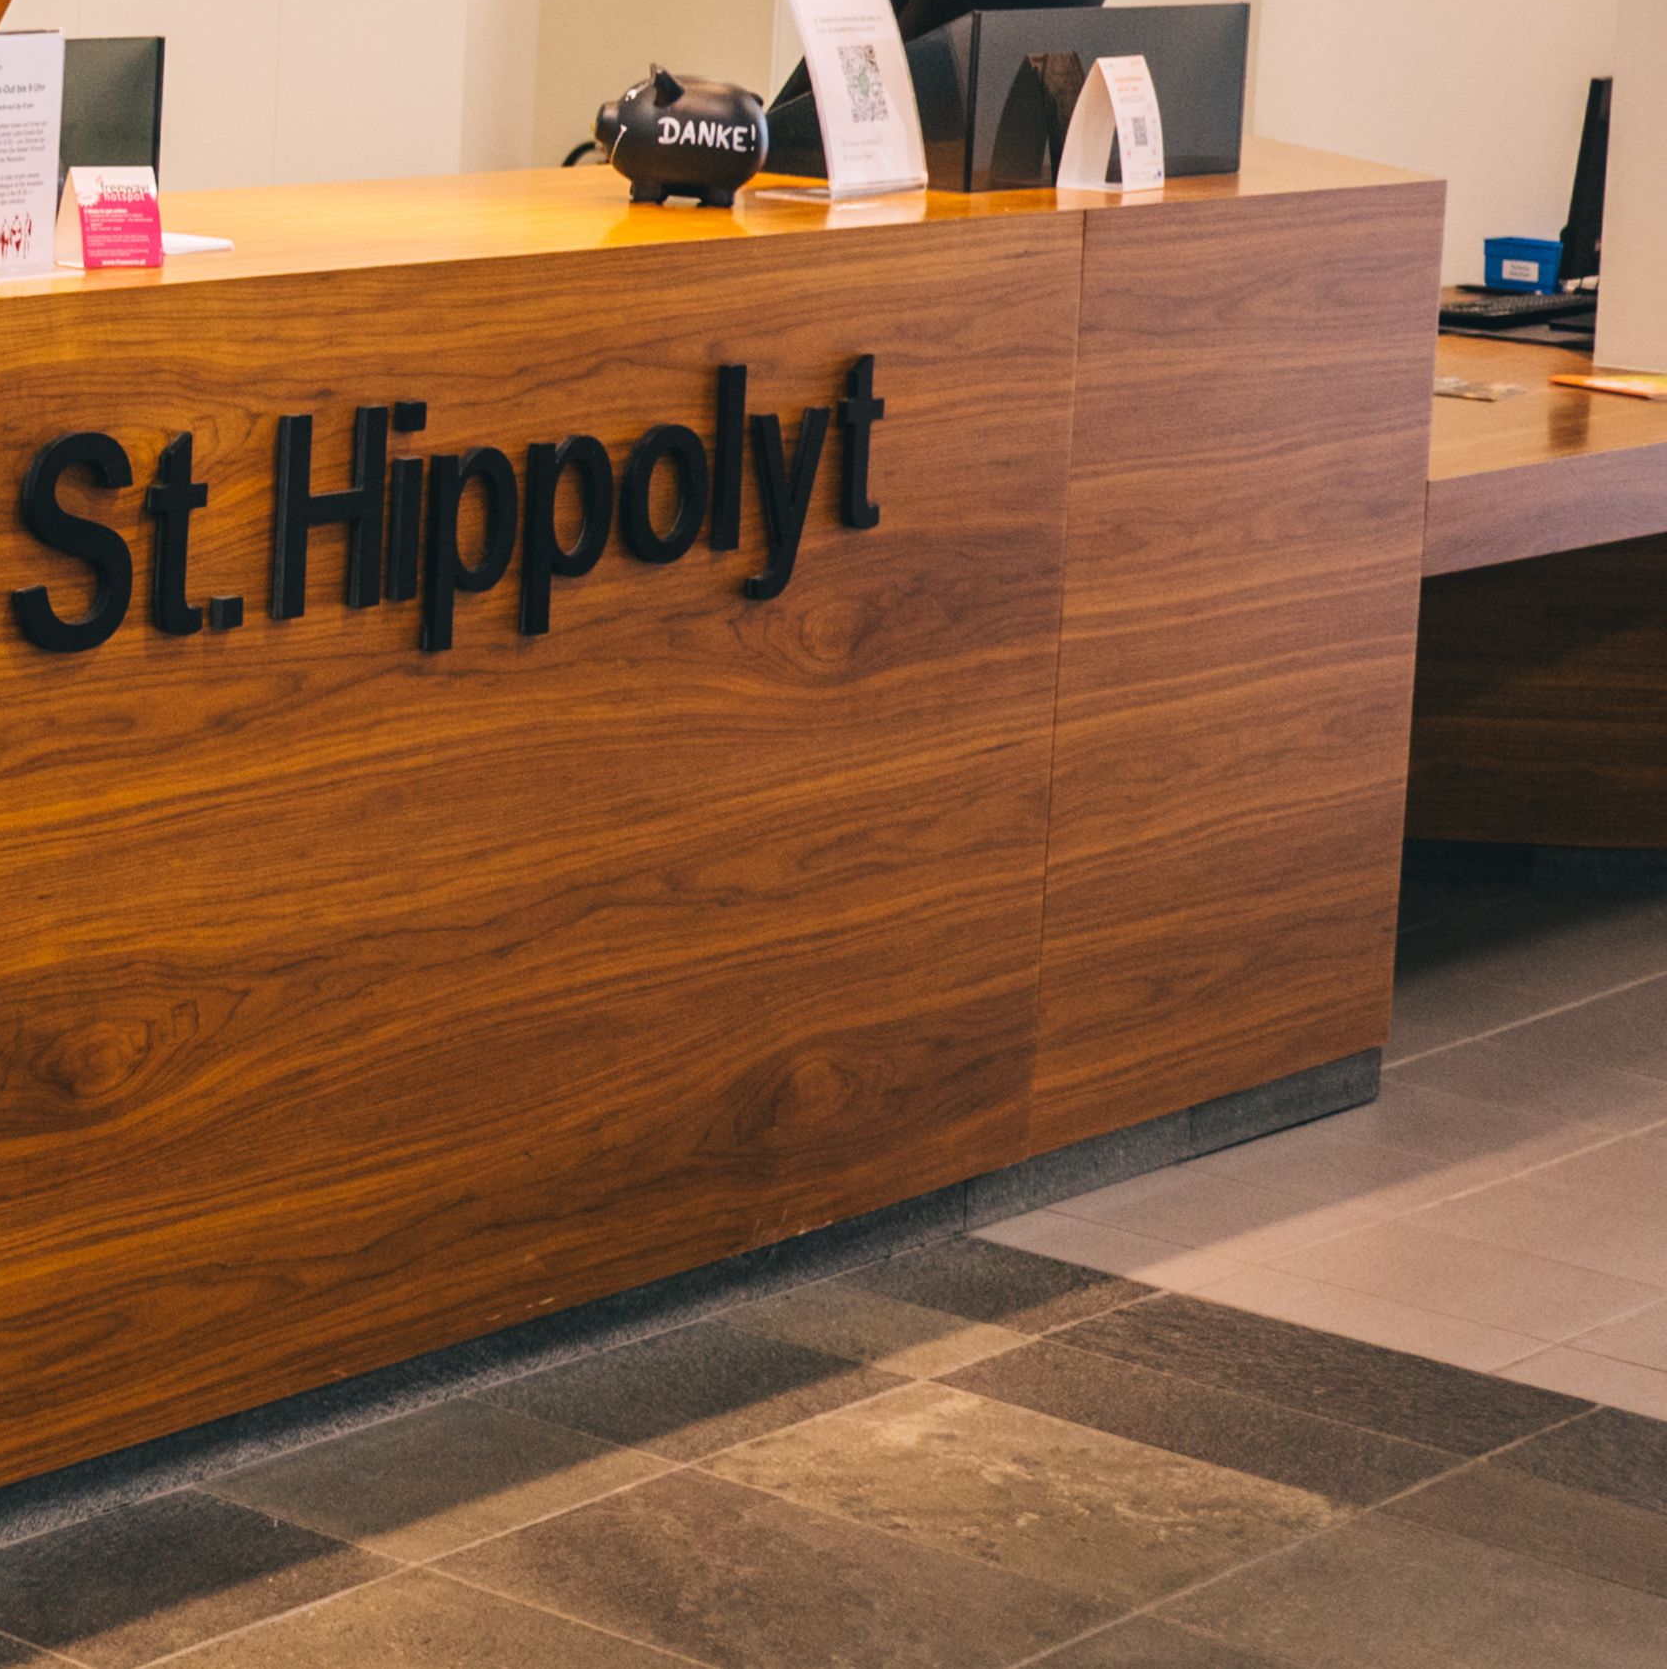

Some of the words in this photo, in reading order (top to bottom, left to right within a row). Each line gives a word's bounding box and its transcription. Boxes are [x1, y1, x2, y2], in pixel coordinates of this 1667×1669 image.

[657, 116, 756, 153] DANKE!
[11, 431, 244, 653] St.
[270, 353, 885, 651] Hippolyt
